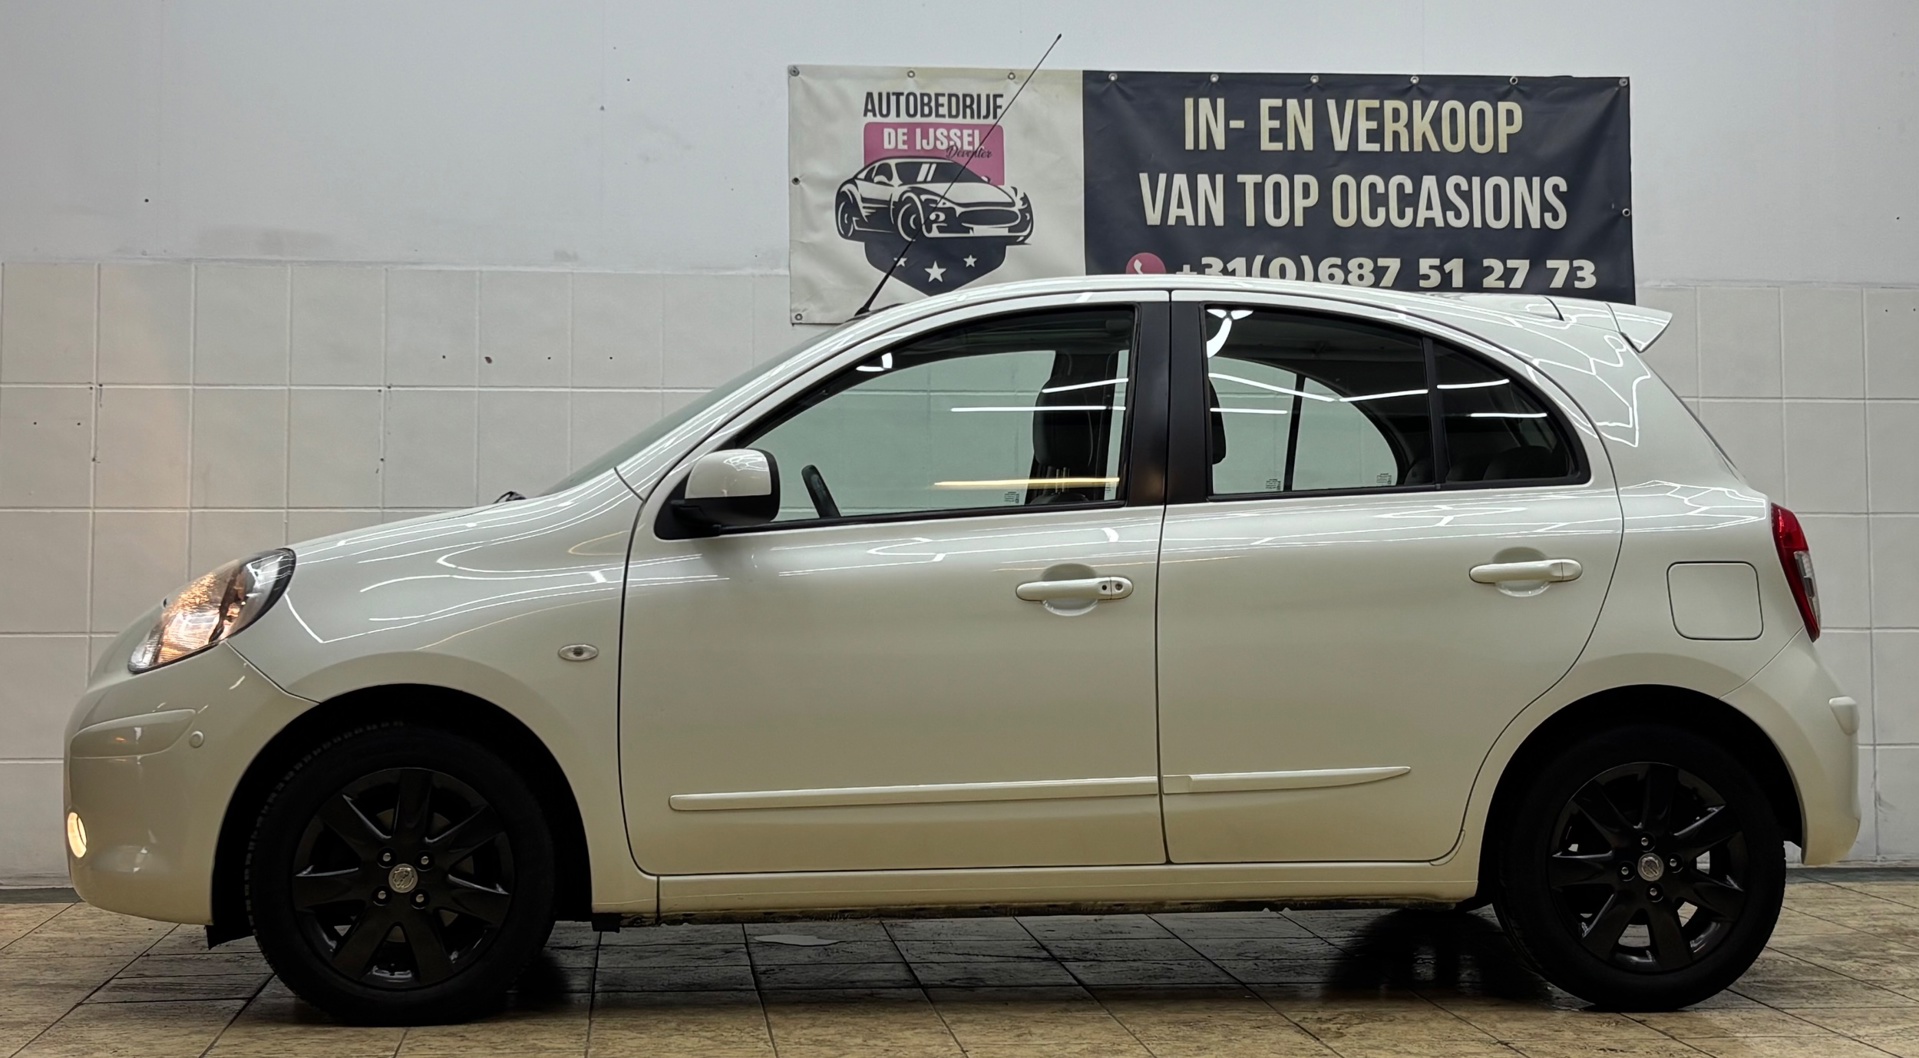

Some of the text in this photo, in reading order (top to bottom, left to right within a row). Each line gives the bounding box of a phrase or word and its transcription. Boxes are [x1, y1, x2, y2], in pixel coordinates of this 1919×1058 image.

[863, 92, 1003, 119] AUTOBEDRIJF
[883, 128, 984, 151] DE IJSSEL
[1185, 97, 1522, 153] IN- EN VERKOOP
[1139, 173, 1567, 229] VAN TOP OCCASIONS
[1418, 258, 1464, 288] 51
[1482, 258, 1530, 289] 27
[1546, 259, 1597, 289] 73
